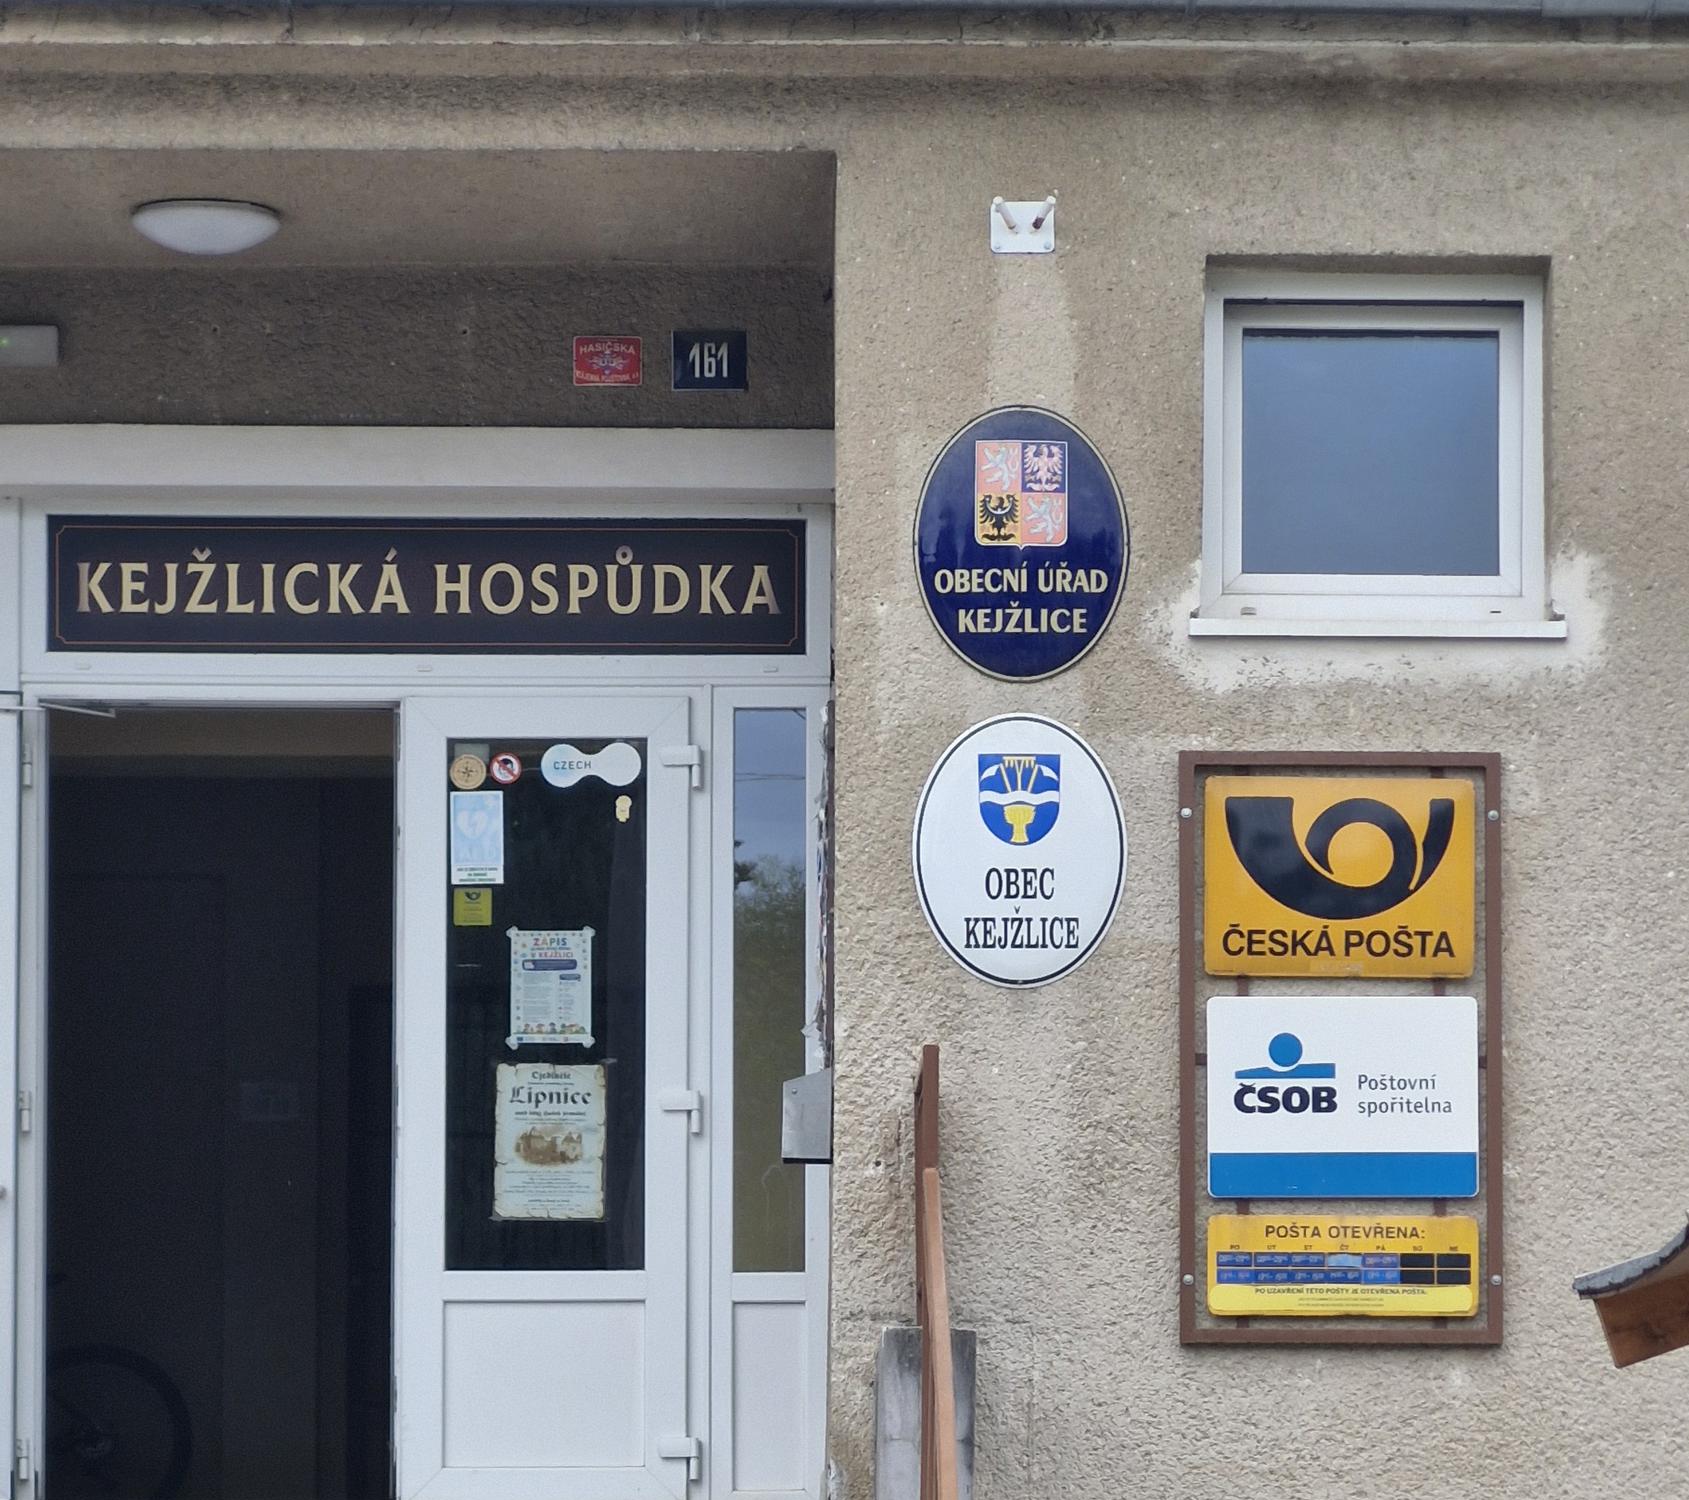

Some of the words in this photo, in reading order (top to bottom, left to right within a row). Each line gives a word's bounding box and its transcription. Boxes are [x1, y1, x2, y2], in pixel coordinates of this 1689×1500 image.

[689, 342, 729, 378] 161
[76, 547, 411, 614] KEJŽLICKÁ
[433, 545, 782, 615] HOSPŮDKA
[934, 561, 1028, 593] OBECNÍ
[1037, 561, 1109, 593] ÚŘAD
[958, 601, 1088, 633] KEJŽLICE
[553, 761, 592, 770] CZECH
[985, 867, 1055, 900] OBEC
[964, 905, 1079, 949] KEJŽLICE
[1222, 923, 1336, 957] ČESKÁ
[1344, 925, 1456, 958] POŠTA
[510, 1086, 591, 1108] Lipnice
[1234, 1082, 1338, 1113] ČSOB
[1358, 1074, 1436, 1090] Poštovní
[1358, 1096, 1452, 1117] spořitelna
[1265, 1222, 1321, 1239] POŠTA
[1328, 1223, 1425, 1239] OTEVŘENA:
[1360, 1287, 1400, 1295] OTEVŘENA
